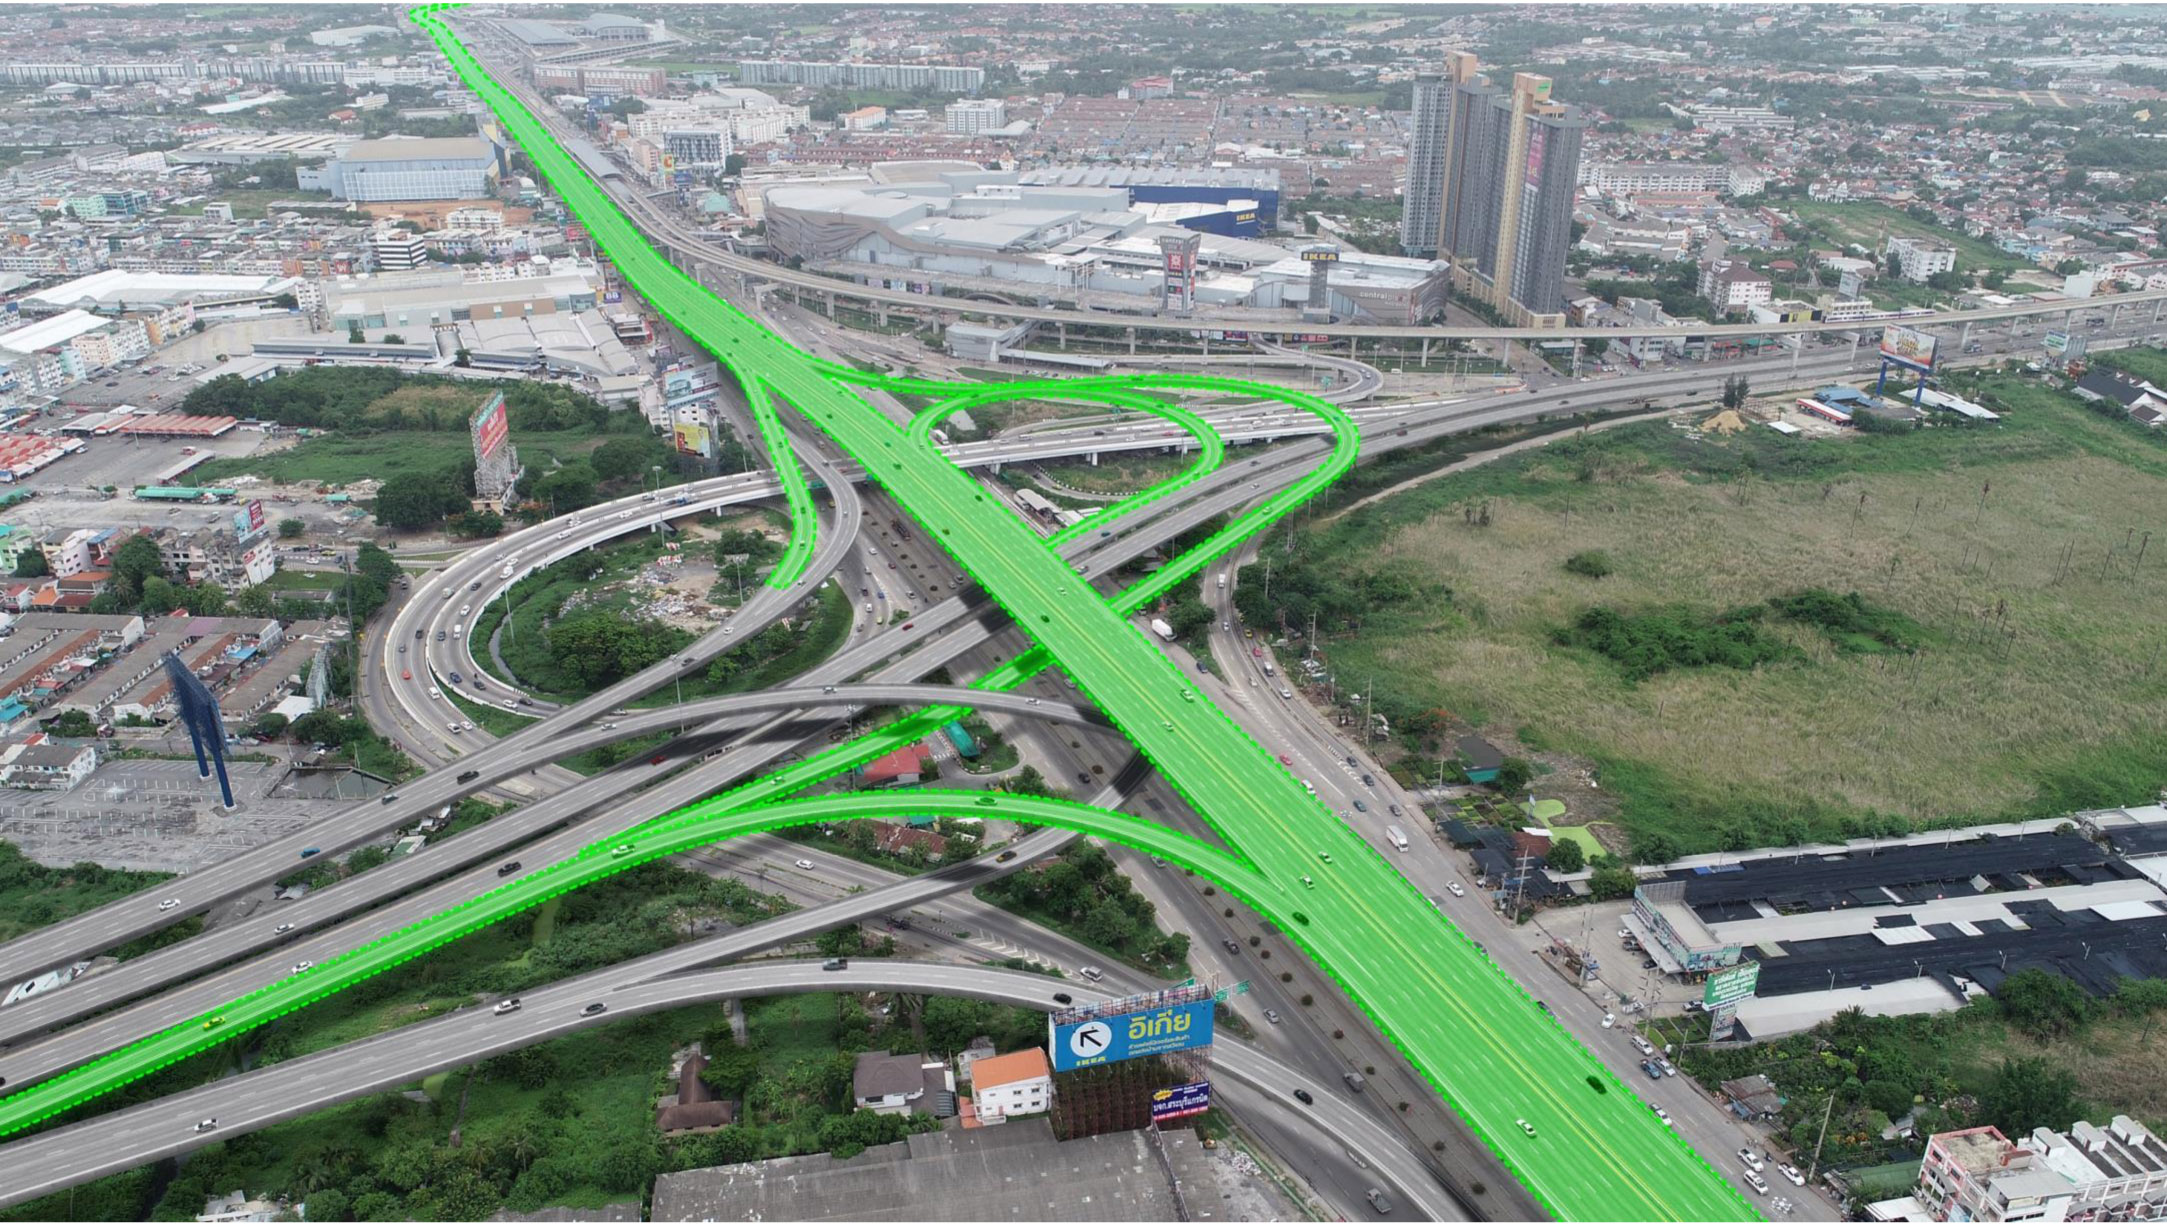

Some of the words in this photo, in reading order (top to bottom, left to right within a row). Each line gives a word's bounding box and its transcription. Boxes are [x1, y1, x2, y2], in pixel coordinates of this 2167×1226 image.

[1236, 212, 1256, 221] IKEA
[1303, 252, 1337, 260] IKEA
[1128, 1009, 1191, 1040] อิเกีย
[1076, 1056, 1106, 1067] IKEA
